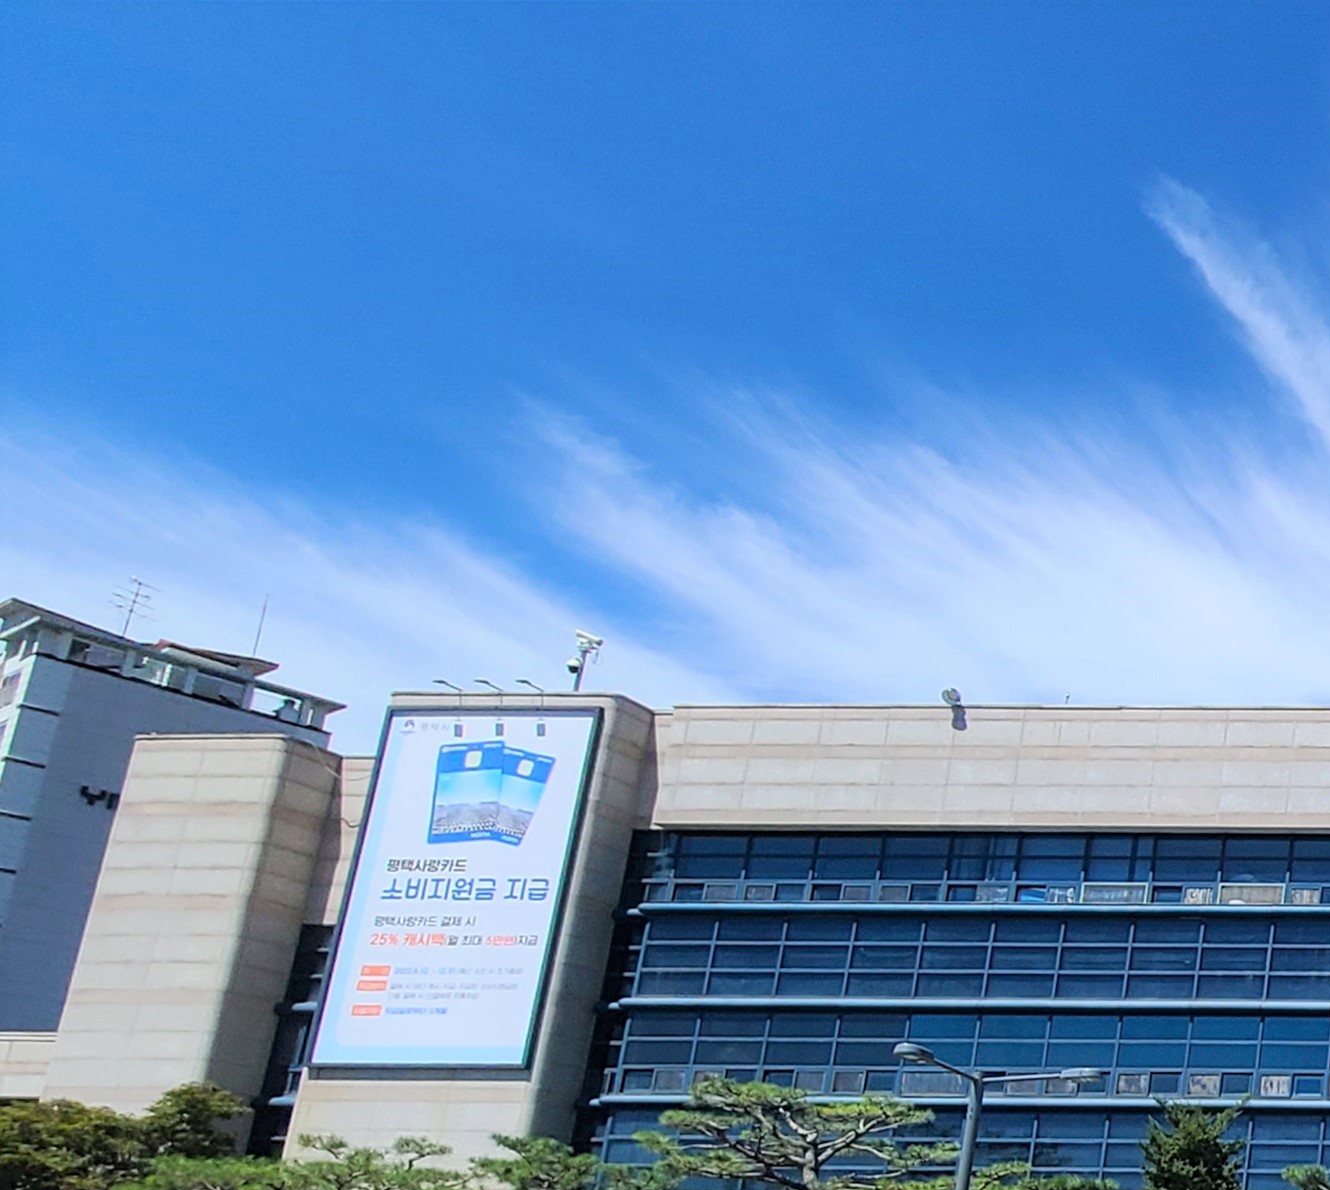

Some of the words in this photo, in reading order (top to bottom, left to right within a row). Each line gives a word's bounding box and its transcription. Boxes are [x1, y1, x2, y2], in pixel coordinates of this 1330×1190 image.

[386, 859, 467, 872] 평택사랑카드
[381, 878, 497, 900] 소비지원금
[504, 878, 550, 900] 지급
[374, 916, 438, 927] 평택사랑카드
[465, 916, 477, 927] 시
[370, 933, 398, 946] 25%
[461, 935, 482, 946] 최대
